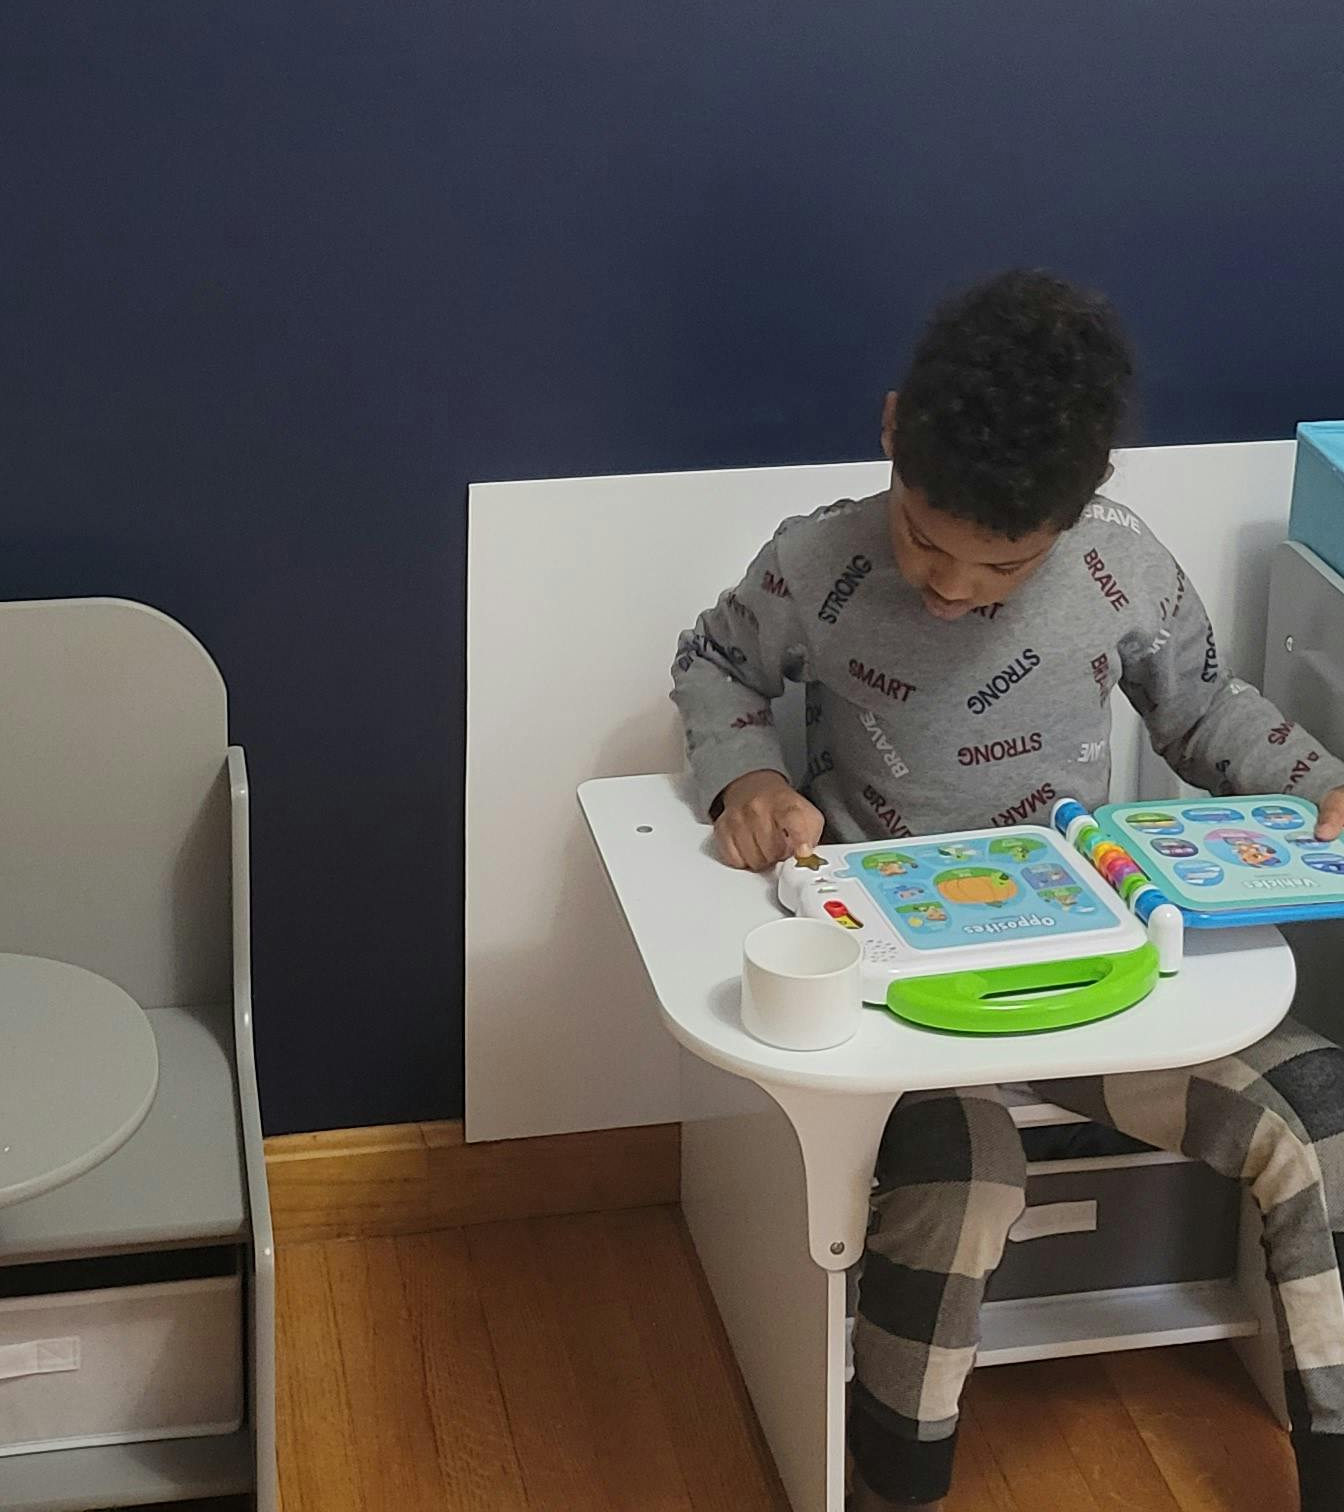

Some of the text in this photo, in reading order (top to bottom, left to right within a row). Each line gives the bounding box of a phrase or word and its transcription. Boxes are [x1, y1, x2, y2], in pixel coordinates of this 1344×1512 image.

[818, 554, 873, 625] STRONG
[1083, 548, 1129, 612] BRAVE
[848, 658, 916, 704] SMART
[967, 648, 1040, 715] STRONG
[859, 711, 909, 778] BRAVE
[957, 732, 1042, 766] STRONG
[963, 914, 1057, 936] Opposites
